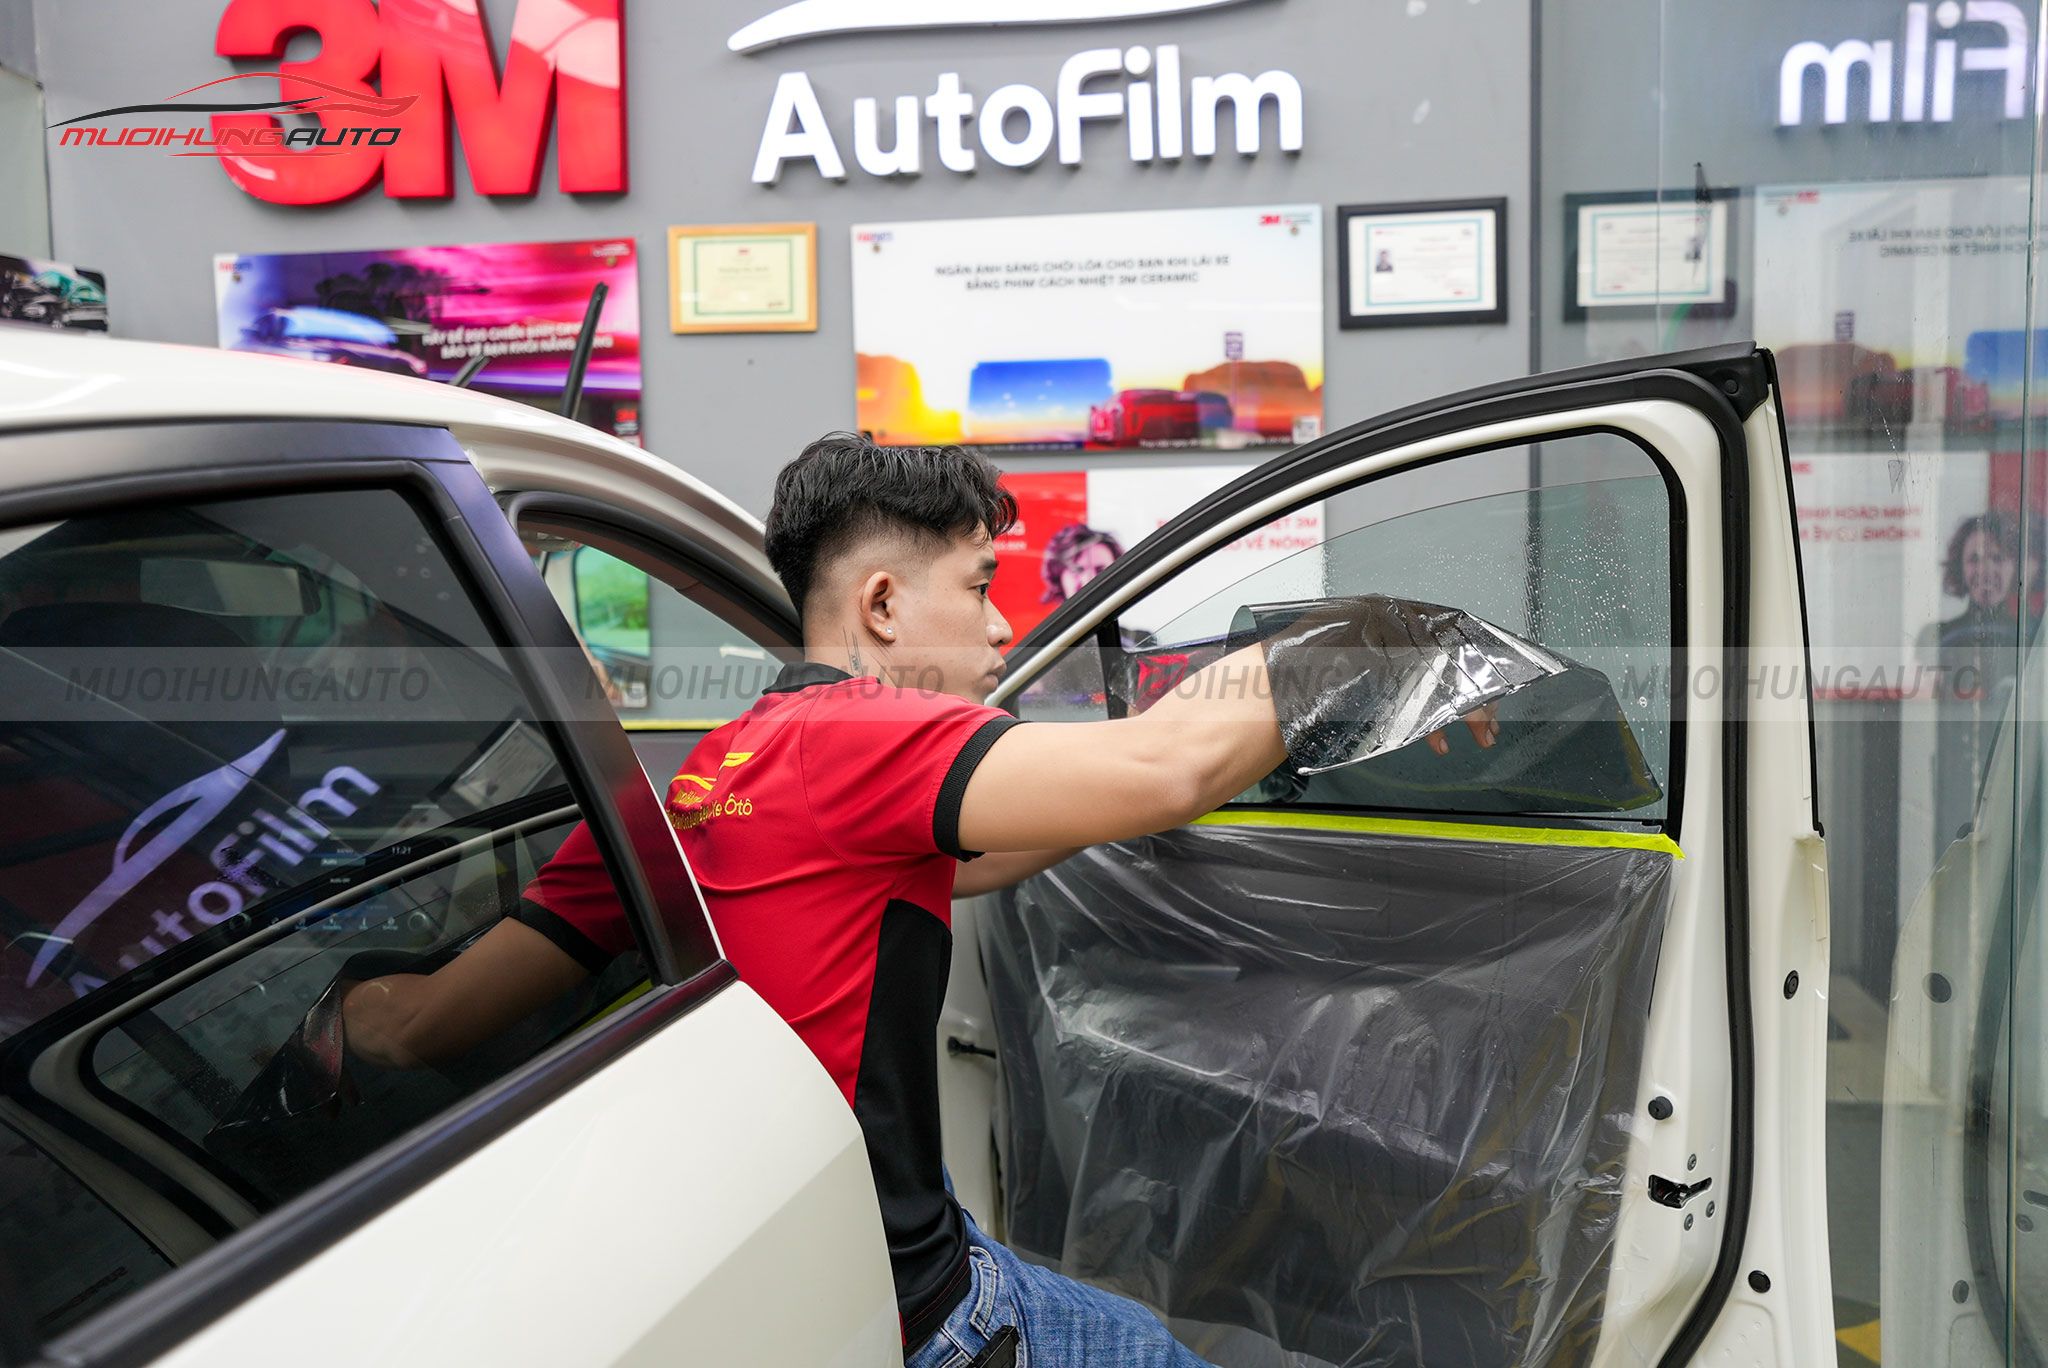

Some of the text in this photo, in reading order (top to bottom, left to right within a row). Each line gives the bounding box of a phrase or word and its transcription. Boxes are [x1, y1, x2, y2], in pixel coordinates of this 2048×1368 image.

[210, 0, 628, 204] 3M
[751, 44, 1304, 187] AutoFilm
[1105, 258, 1135, 271] CHO
[1167, 256, 1188, 268] KHI
[1004, 277, 1035, 289] PHIM
[1119, 274, 1137, 286] 3M
[1140, 271, 1199, 284] CERAMIC
[1295, 516, 1318, 530] 3M
[724, 792, 753, 816] Ôtô
